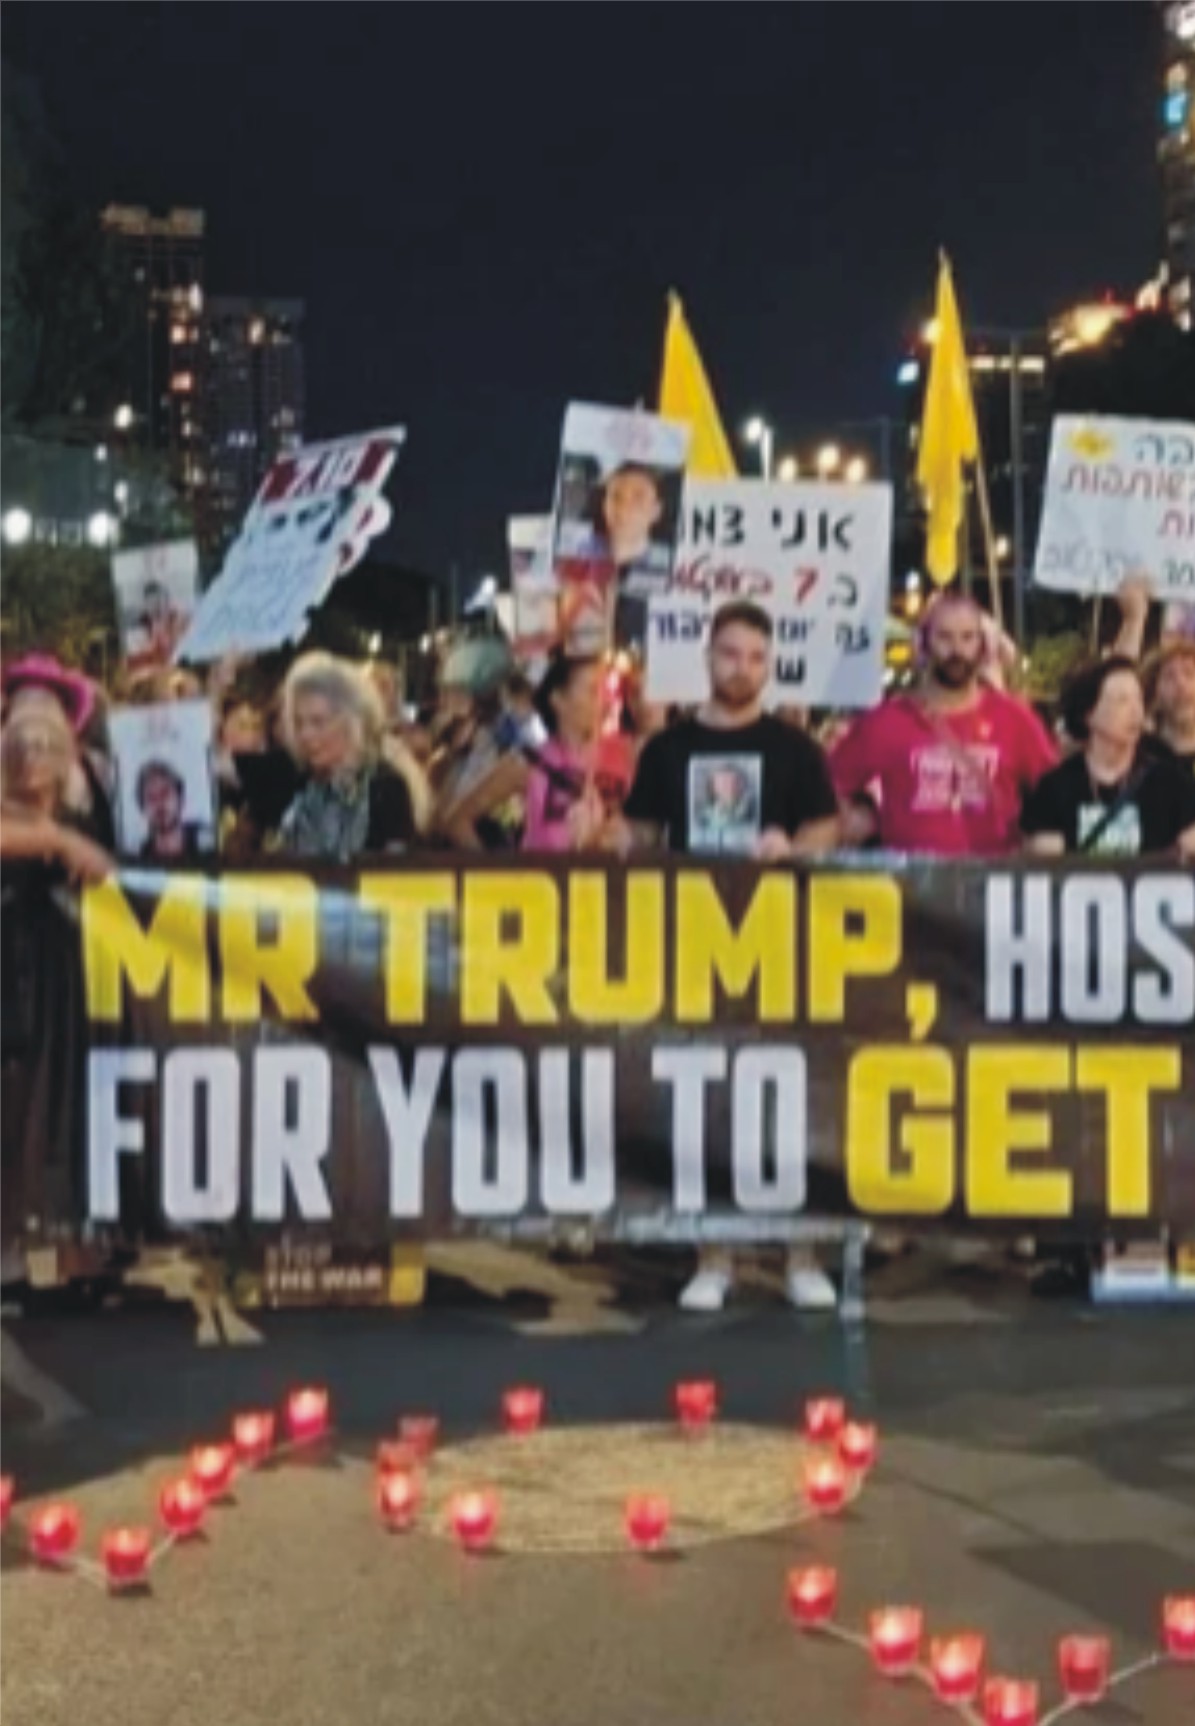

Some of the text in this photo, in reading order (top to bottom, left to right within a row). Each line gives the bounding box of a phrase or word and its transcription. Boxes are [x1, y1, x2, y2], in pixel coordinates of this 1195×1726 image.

[771, 507, 854, 553] אני
[81, 871, 319, 1022] MR
[358, 871, 938, 1041] TRUMP,
[88, 1046, 332, 1221] FOR
[369, 1046, 615, 1219] YOU
[651, 1046, 807, 1214] TO
[846, 1045, 1182, 1217] GET
[265, 1268, 316, 1292] THE
